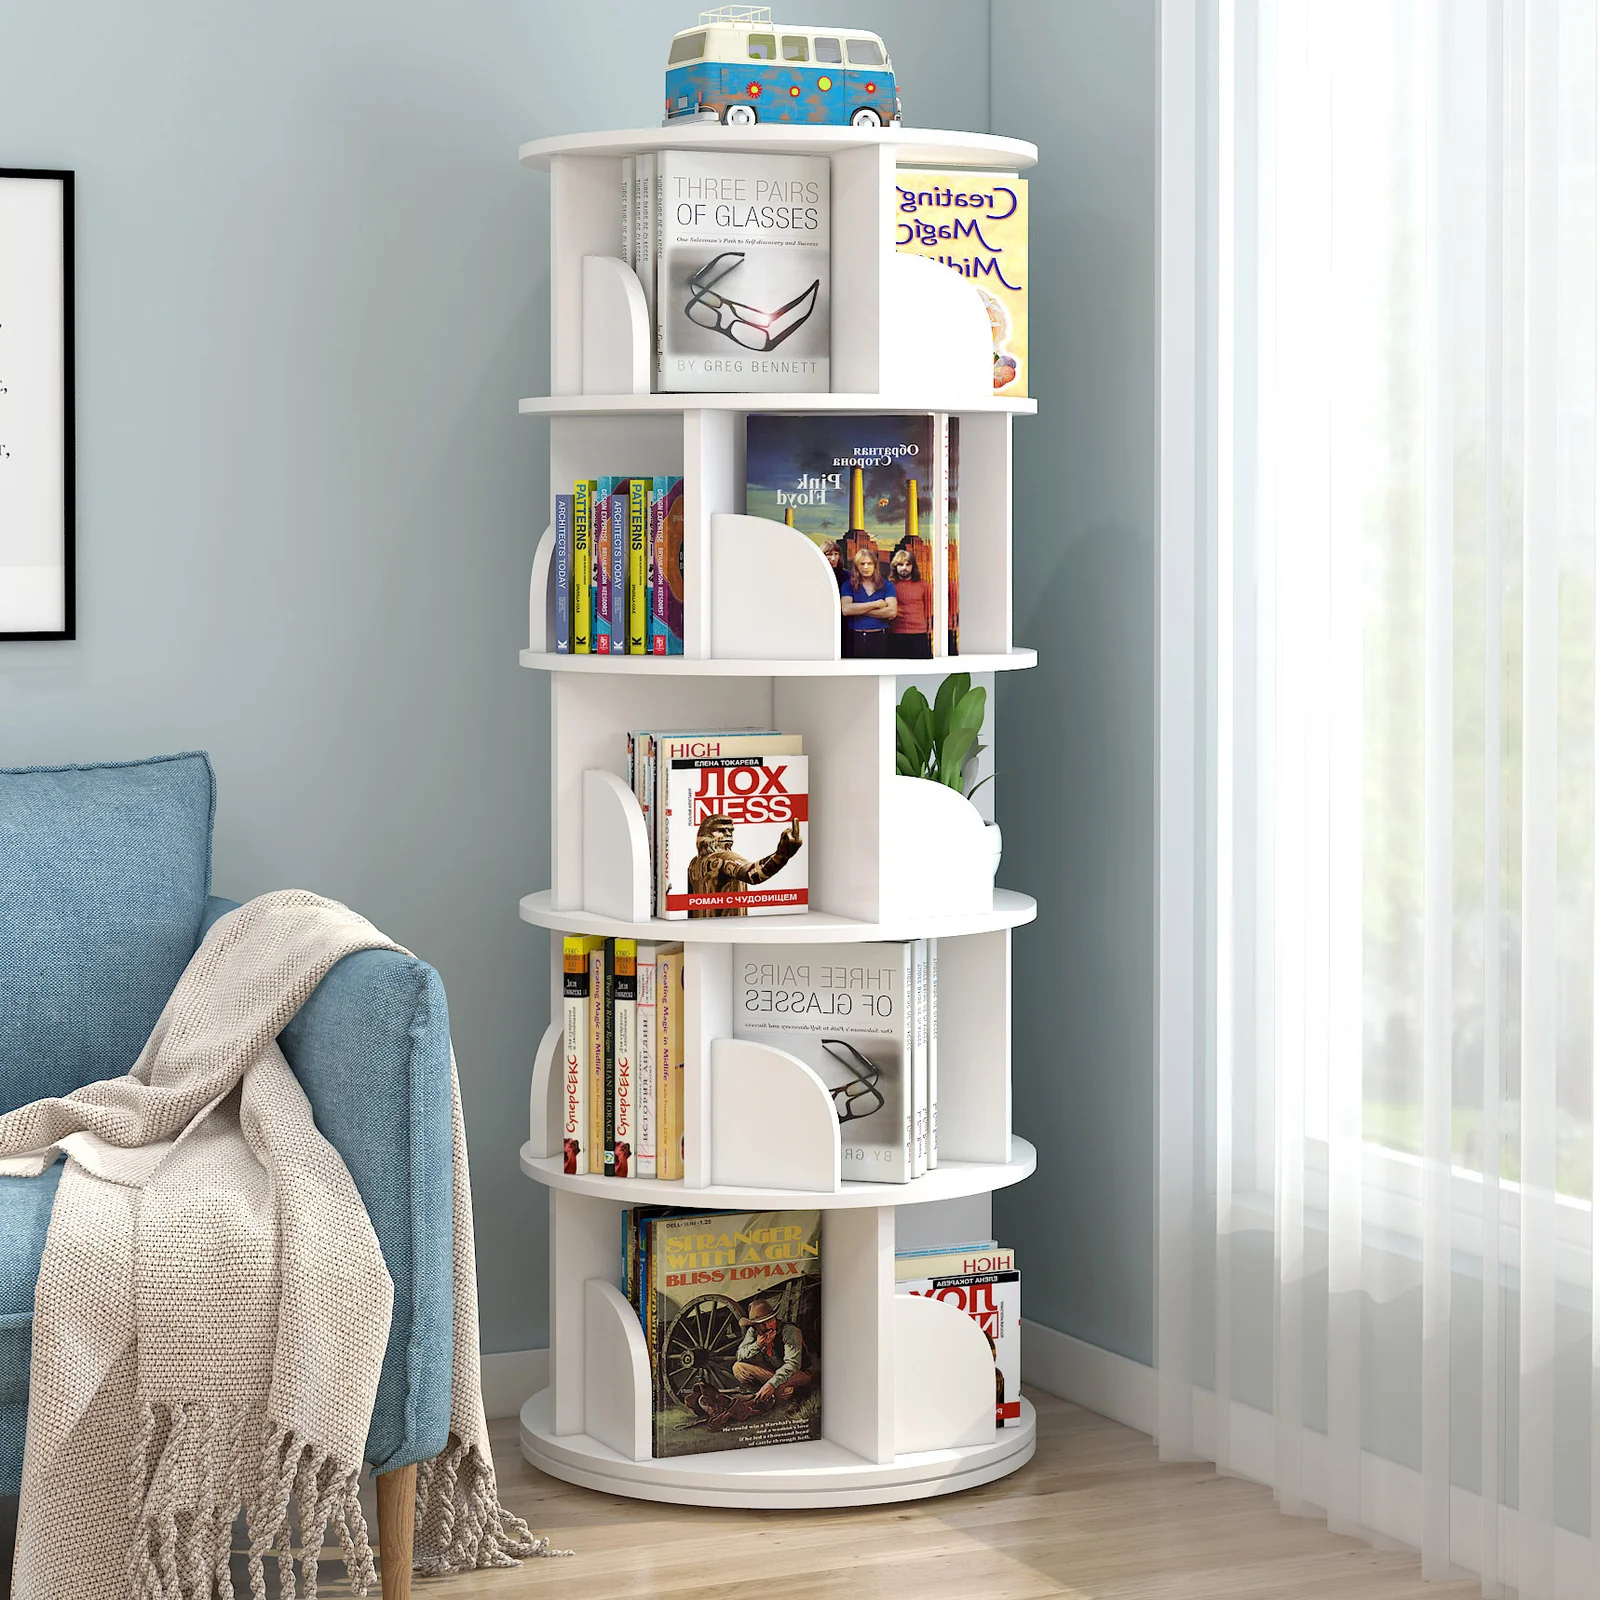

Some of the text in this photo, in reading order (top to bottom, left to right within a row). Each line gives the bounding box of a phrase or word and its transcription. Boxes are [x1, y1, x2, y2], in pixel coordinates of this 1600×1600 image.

[673, 176, 820, 204] THREE PAIRS
[676, 204, 819, 230] OF GLASSES
[677, 360, 817, 374] BY GREG BENNETT
[576, 484, 586, 550] PATTERNS
[632, 484, 642, 550] PATTERNS
[670, 743, 720, 758] HIGH
[695, 765, 788, 797] ЛОХ
[695, 797, 792, 825] NESS
[689, 897, 722, 906] РОМАН
[735, 893, 798, 904] ЧУДОВИЩЕМ
[596, 1031, 601, 1040] in
[566, 1054, 579, 1133] СуперСЕКС
[617, 1057, 630, 1136] СуперСЕКС
[666, 1225, 803, 1253] STRANGER
[666, 1240, 819, 1270] WITH A GUN
[666, 1262, 798, 1287] BLISS LOMAX
